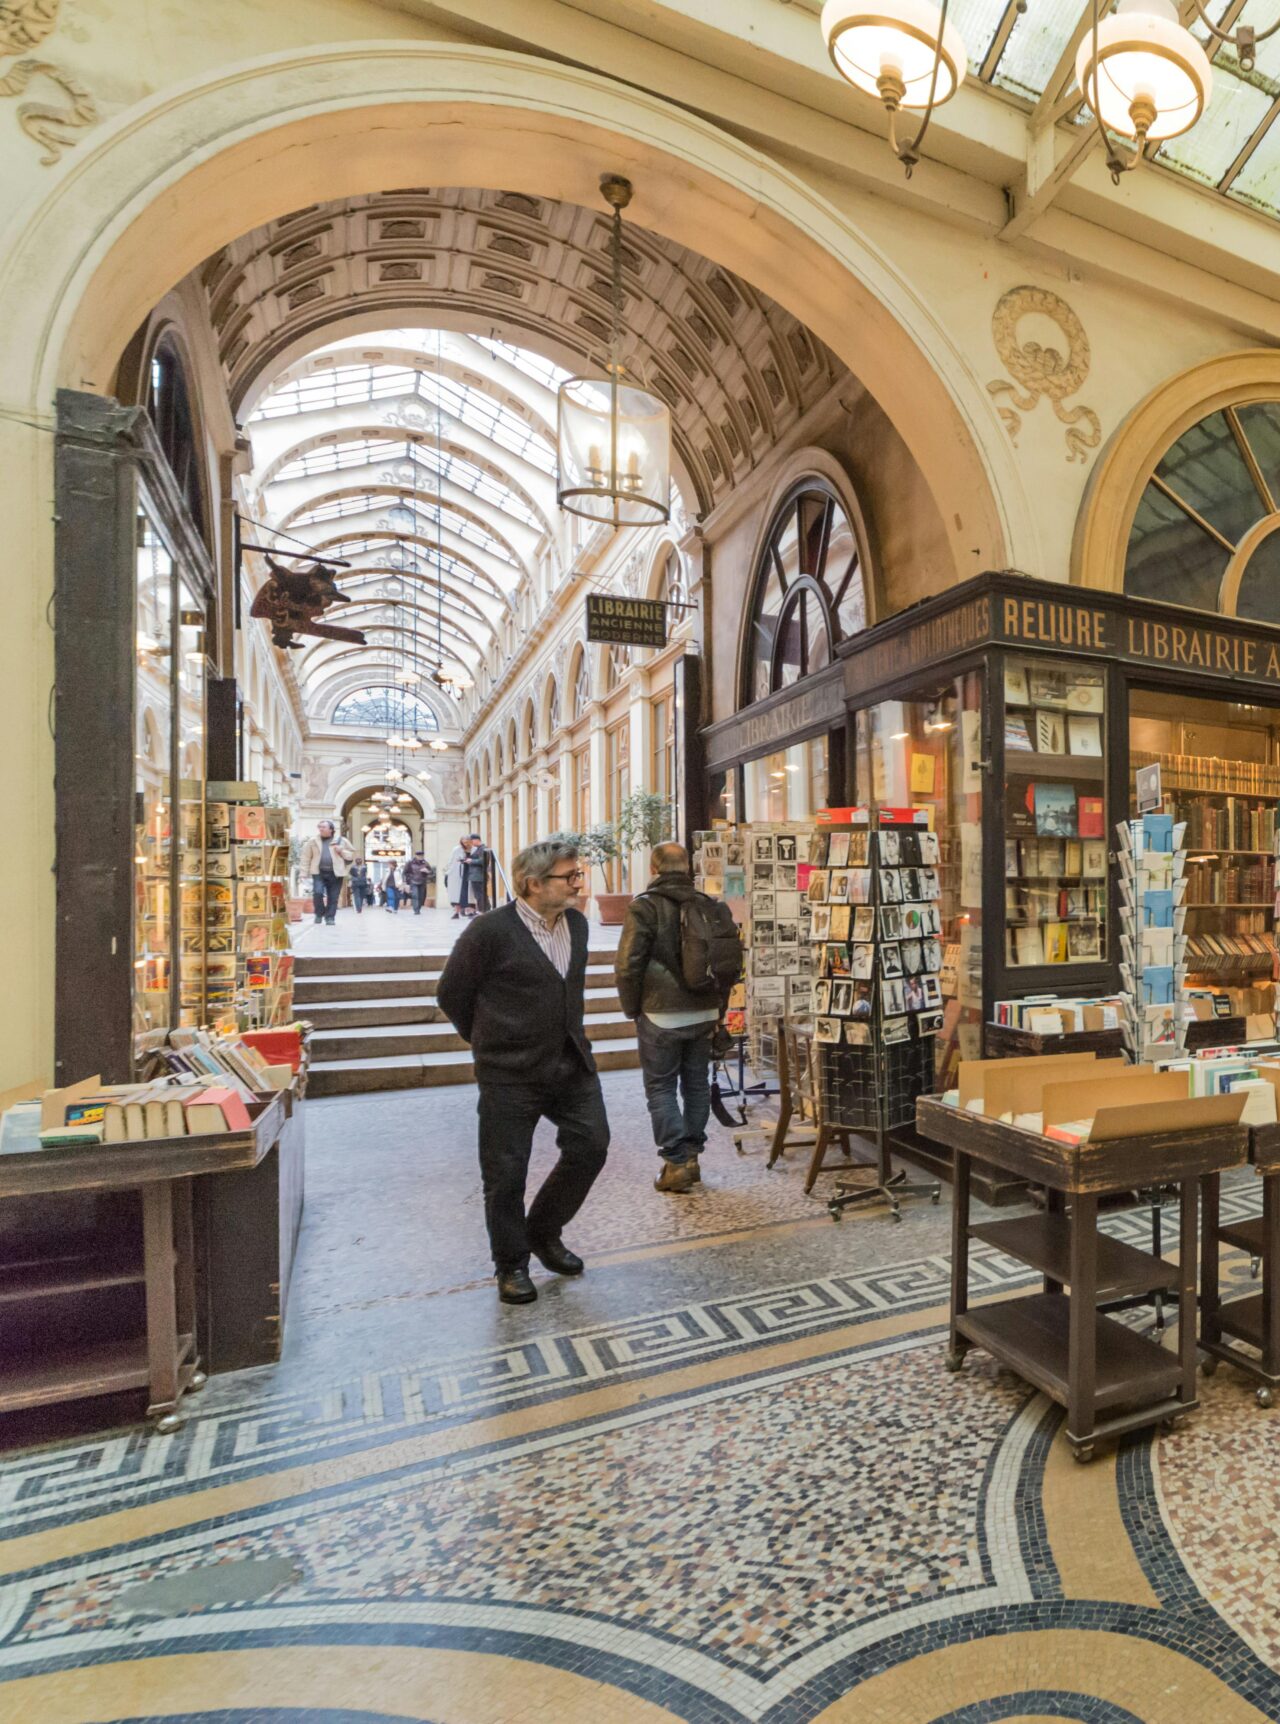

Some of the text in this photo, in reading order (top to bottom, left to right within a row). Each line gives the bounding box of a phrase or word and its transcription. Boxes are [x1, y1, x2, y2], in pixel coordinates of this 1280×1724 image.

[589, 598, 662, 620] LIBRAIRIE
[591, 616, 662, 633] ANCIENNE
[1003, 598, 1106, 648] RELIURE
[590, 629, 662, 645] MODERNE
[1128, 618, 1257, 674] LIBRAIRIE
[741, 690, 812, 748] LIBRAIRIE
